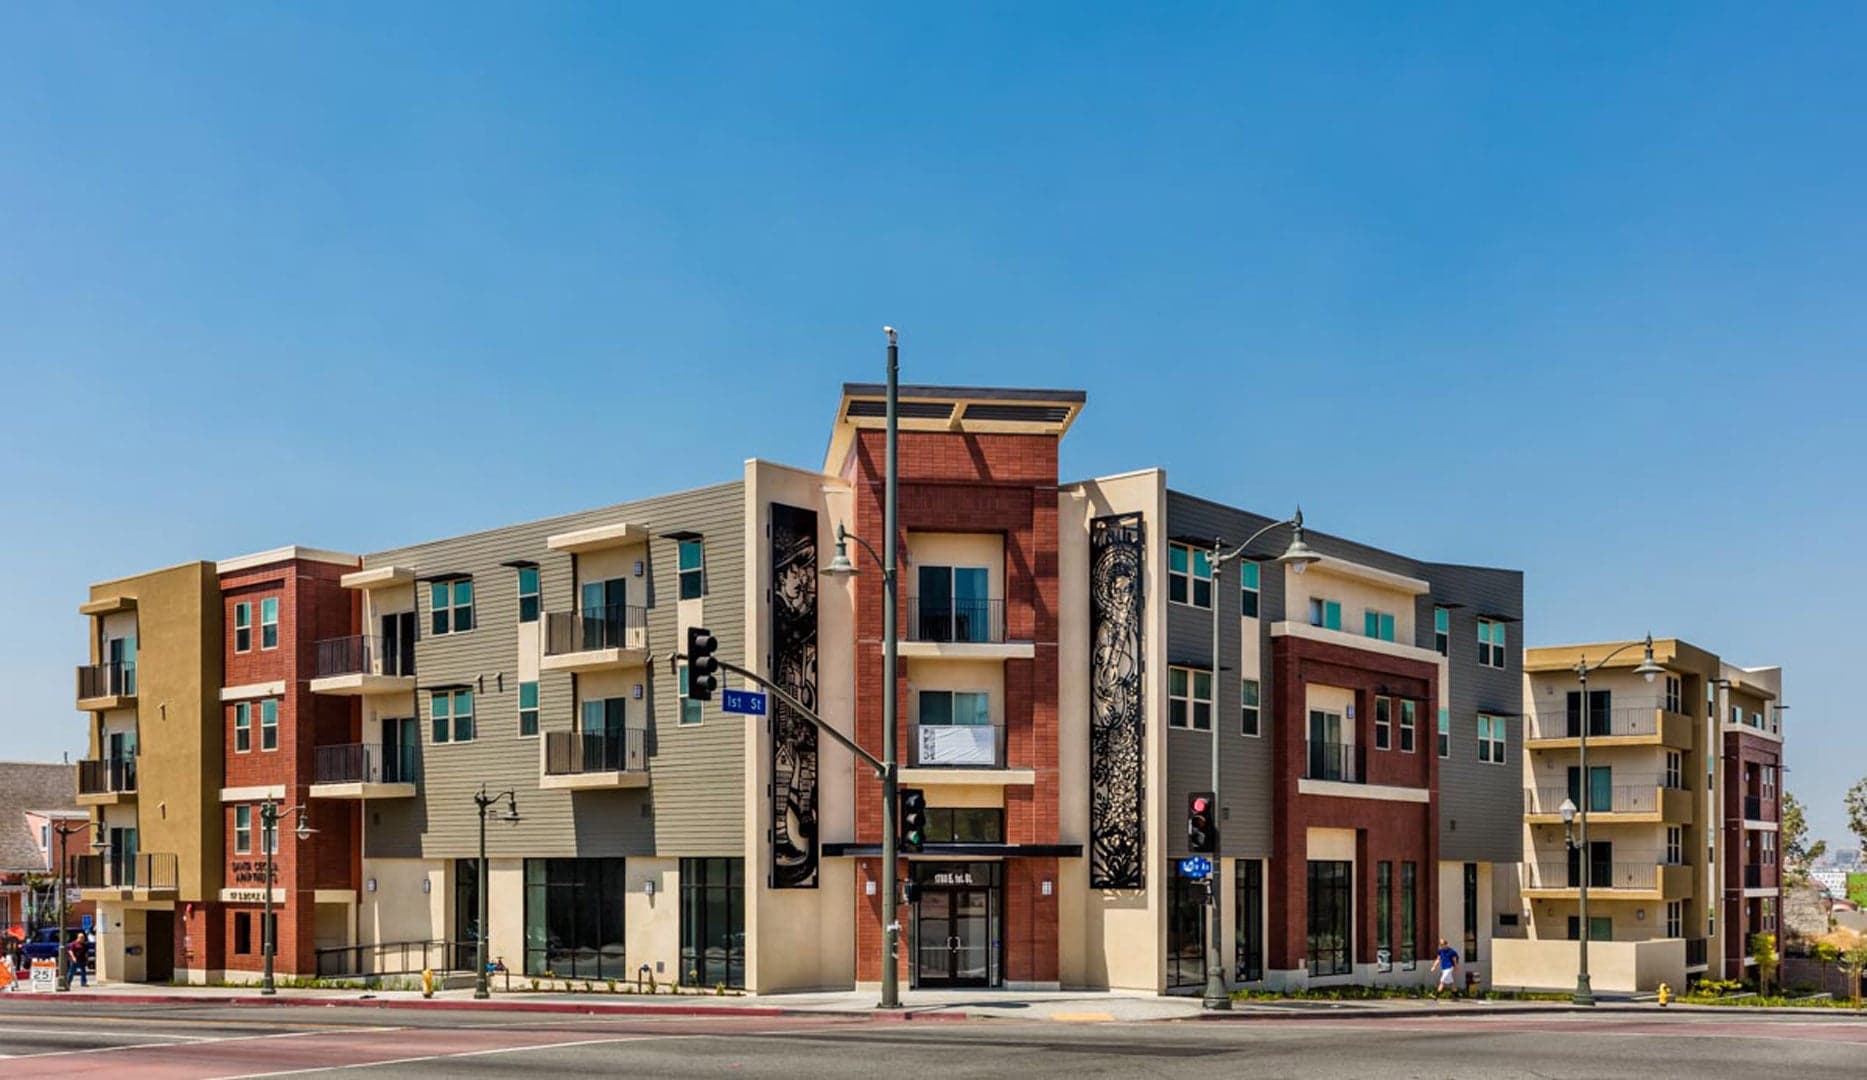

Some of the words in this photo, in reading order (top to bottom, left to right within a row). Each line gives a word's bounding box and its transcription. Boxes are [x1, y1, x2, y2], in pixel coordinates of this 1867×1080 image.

[728, 695, 741, 709] 1st
[750, 697, 761, 710] St
[33, 970, 49, 980] 25
